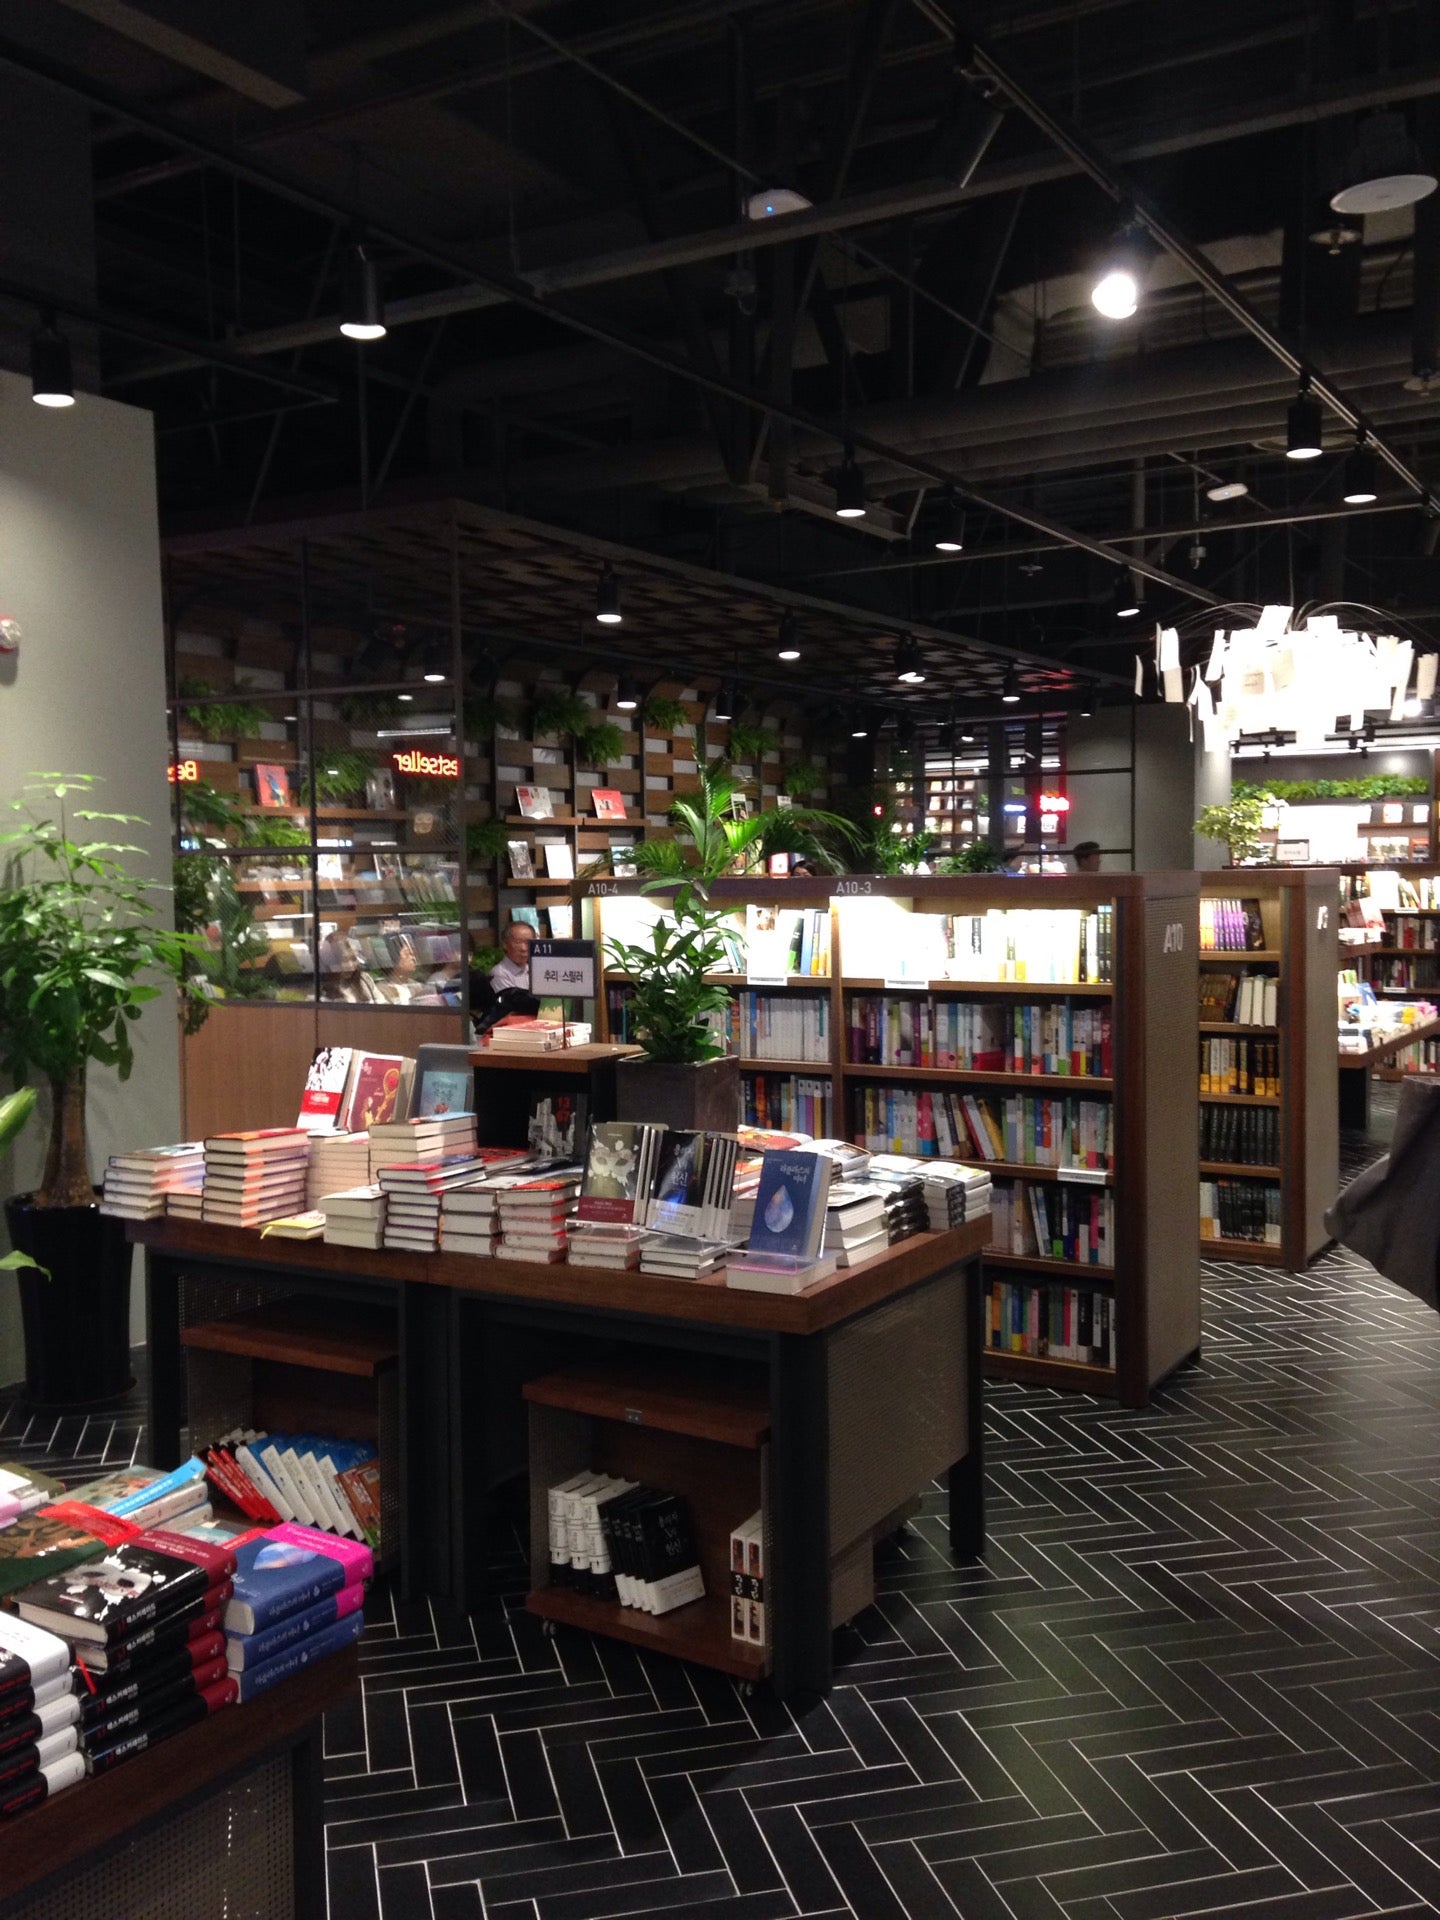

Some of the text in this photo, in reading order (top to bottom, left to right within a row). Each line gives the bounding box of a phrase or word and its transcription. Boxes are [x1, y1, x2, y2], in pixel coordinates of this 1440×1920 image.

[588, 883, 618, 894] A10-4
[836, 881, 871, 894] A10-3
[1163, 923, 1183, 953] A10
[544, 970, 583, 983] 추리 스릴러
